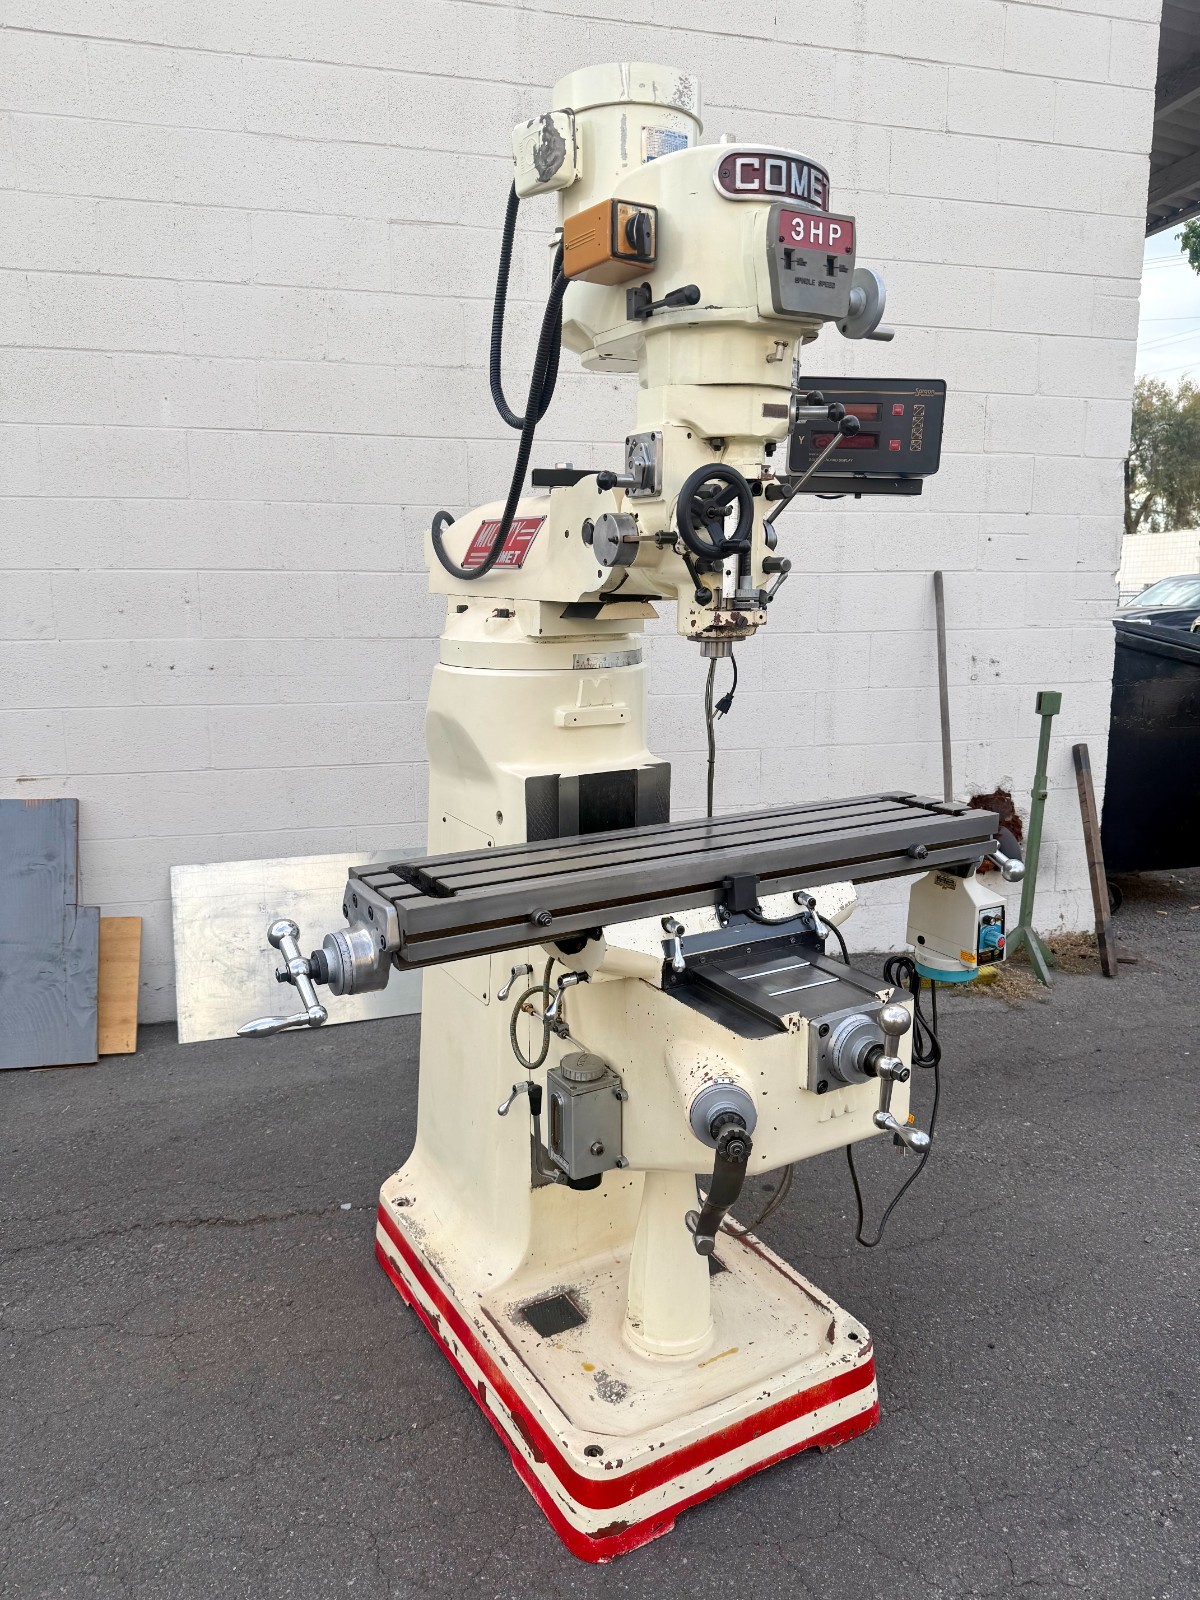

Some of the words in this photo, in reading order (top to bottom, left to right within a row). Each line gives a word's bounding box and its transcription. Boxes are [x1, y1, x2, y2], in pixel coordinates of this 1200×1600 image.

[799, 435, 805, 445] Y
[474, 521, 526, 548] MIGTY
[496, 551, 521, 563] MET
